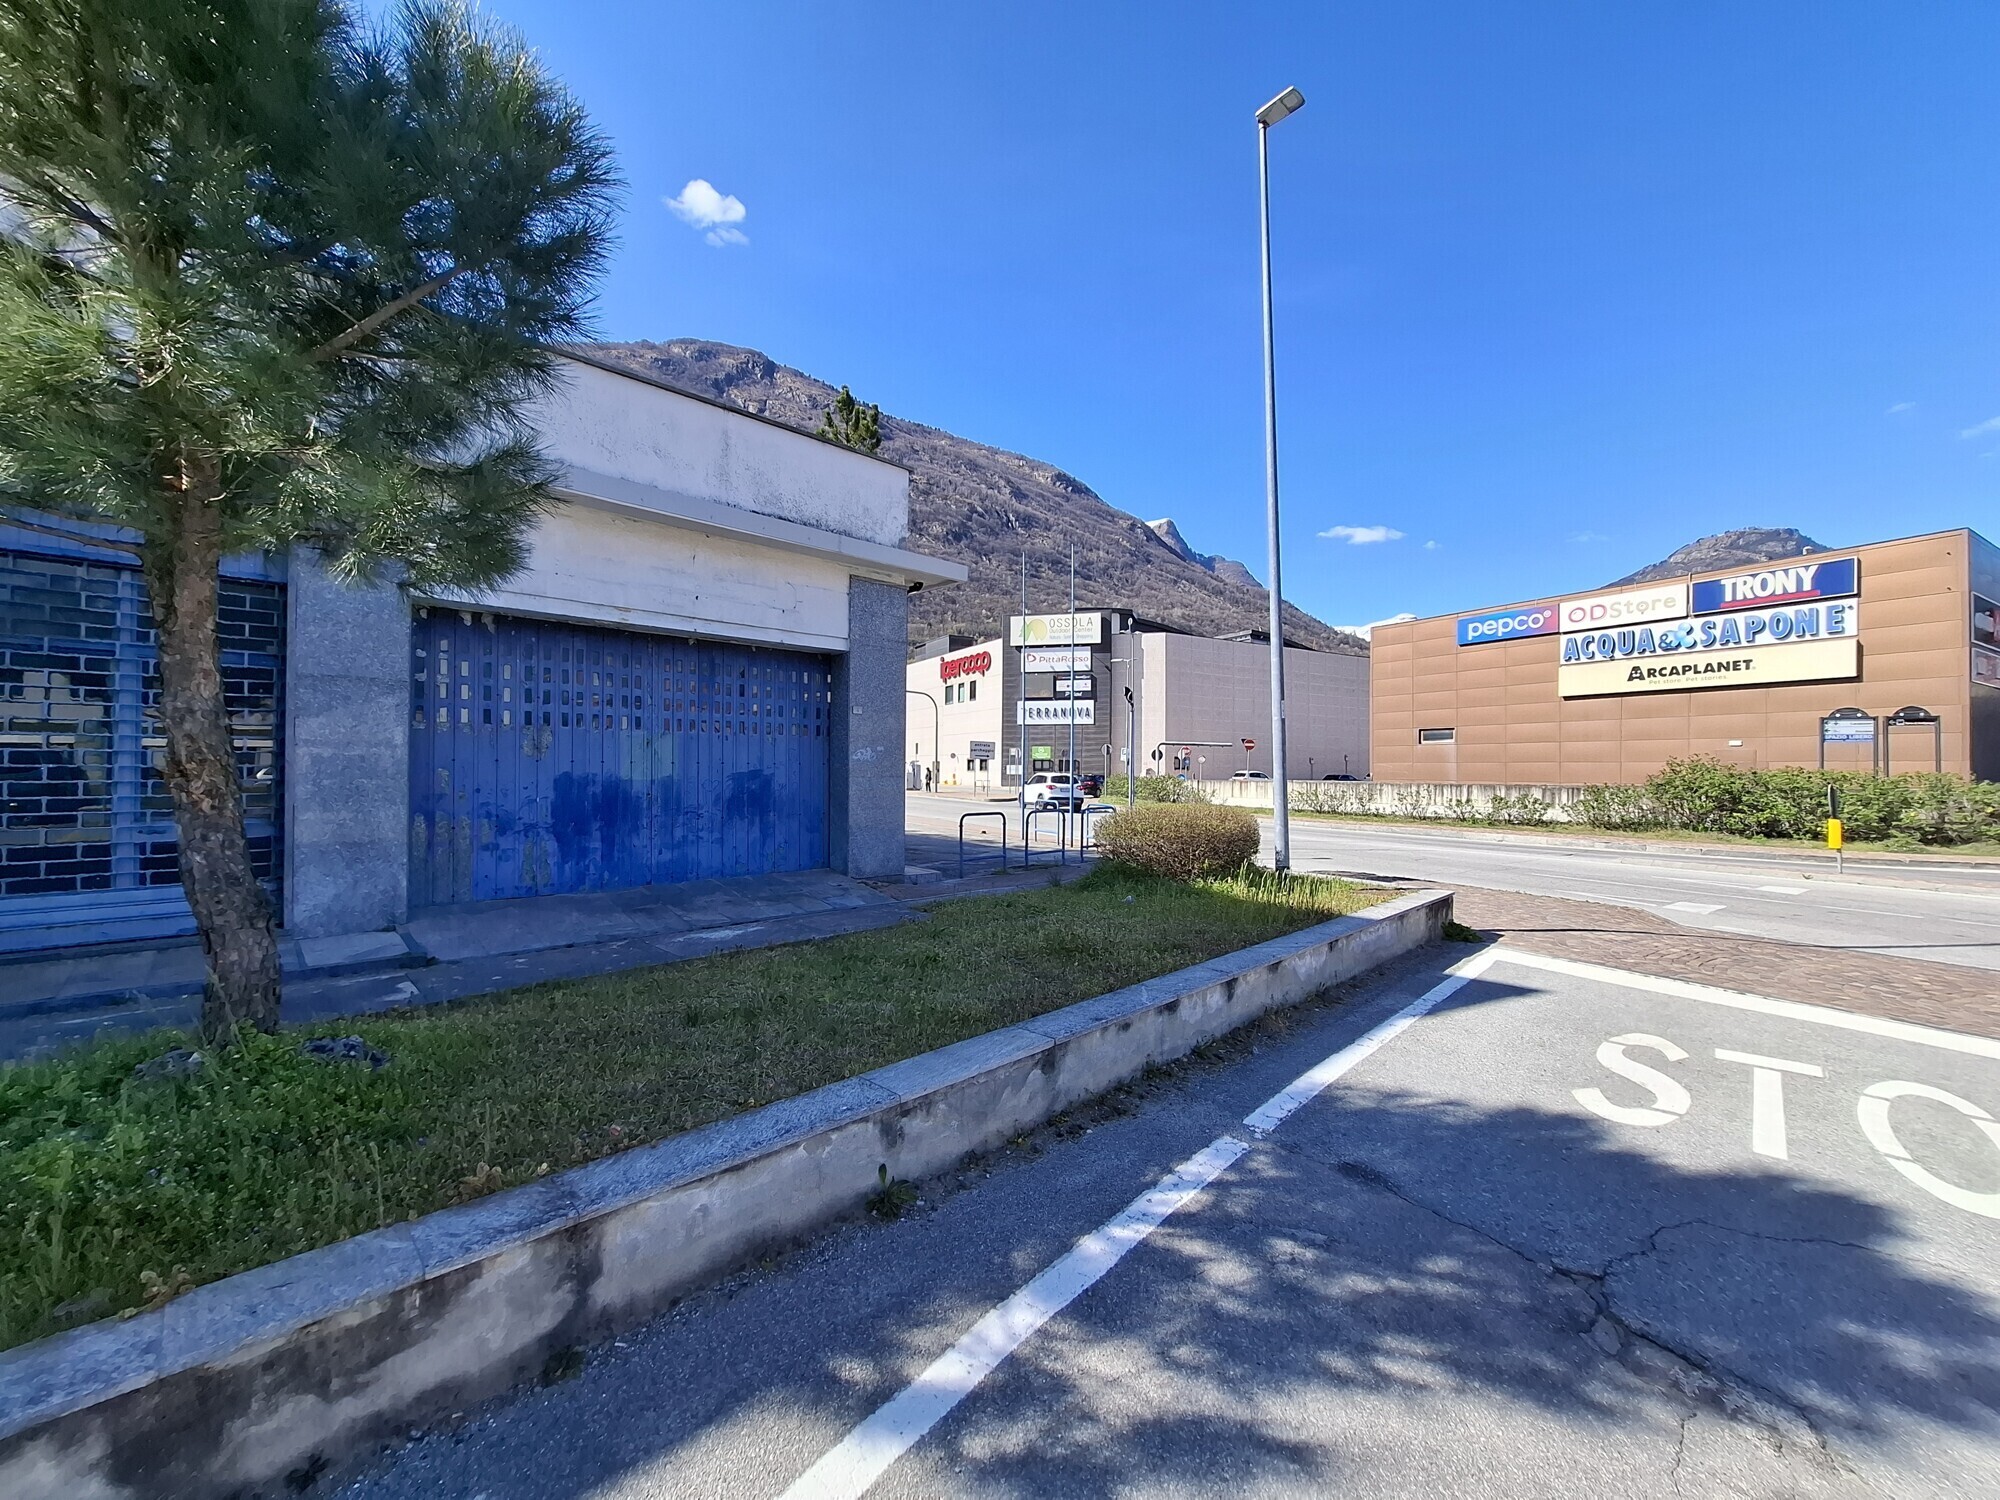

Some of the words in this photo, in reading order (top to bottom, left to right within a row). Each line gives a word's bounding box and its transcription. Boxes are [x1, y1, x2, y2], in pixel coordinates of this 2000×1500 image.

[1721, 565, 1820, 602] TRONY
[1049, 616, 1094, 628] OSSOLA
[1467, 611, 1544, 641] pepco
[1563, 627, 1656, 662] ACQUA
[1700, 604, 1846, 647] SAPONE
[940, 651, 991, 684] ipercoop
[1039, 655, 1089, 663] PittaRosso
[1627, 659, 1753, 681] ARCAPLANET
